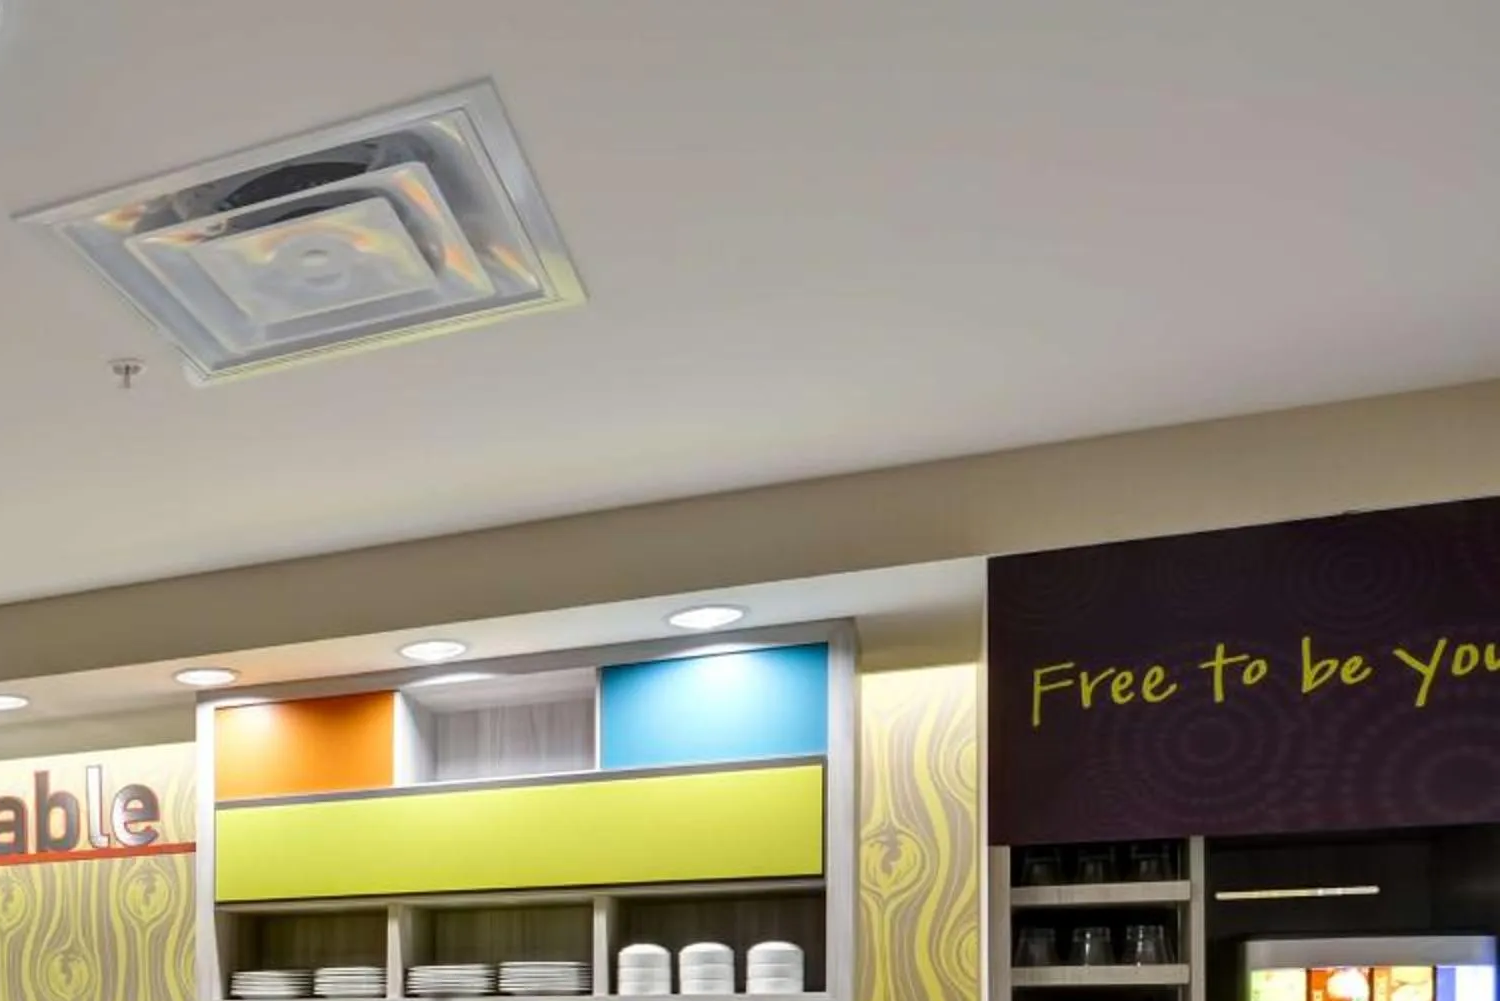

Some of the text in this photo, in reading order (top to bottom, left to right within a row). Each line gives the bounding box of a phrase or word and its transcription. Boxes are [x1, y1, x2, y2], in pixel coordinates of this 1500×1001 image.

[1032, 661, 1178, 727] Free
[1199, 642, 1269, 703] to
[1301, 636, 1373, 694] be
